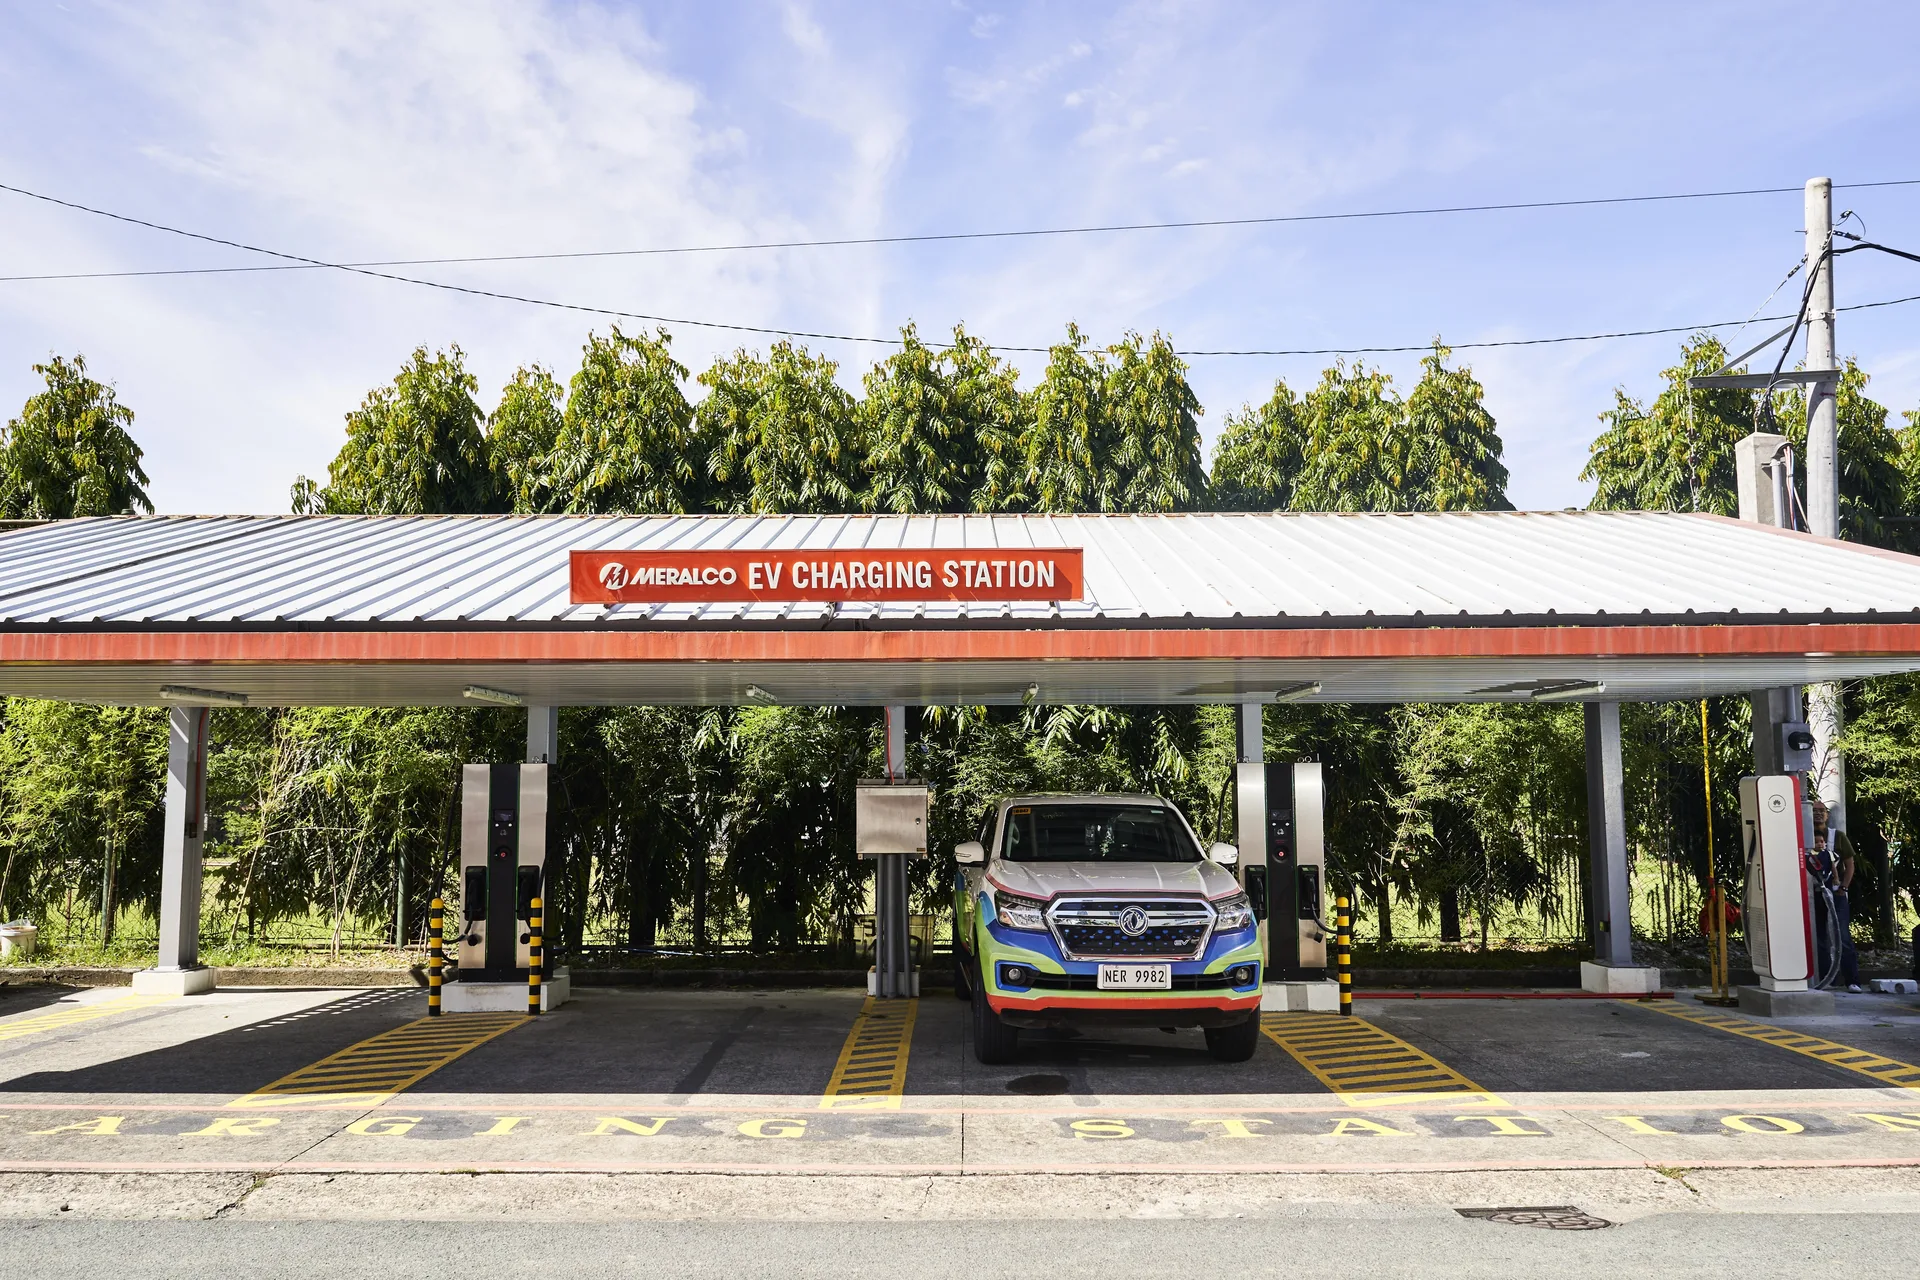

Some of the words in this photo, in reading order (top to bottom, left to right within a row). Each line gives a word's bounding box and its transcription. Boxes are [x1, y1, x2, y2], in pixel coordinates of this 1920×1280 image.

[629, 567, 737, 586] MERALCO
[748, 562, 783, 590] EV
[792, 561, 932, 589] CHARGING
[942, 560, 1055, 588] STATION
[1105, 970, 1127, 982] NER
[1135, 970, 1165, 982] 9982
[0, 1115, 808, 1139] ARGING
[1070, 1112, 1920, 1139] STATION
